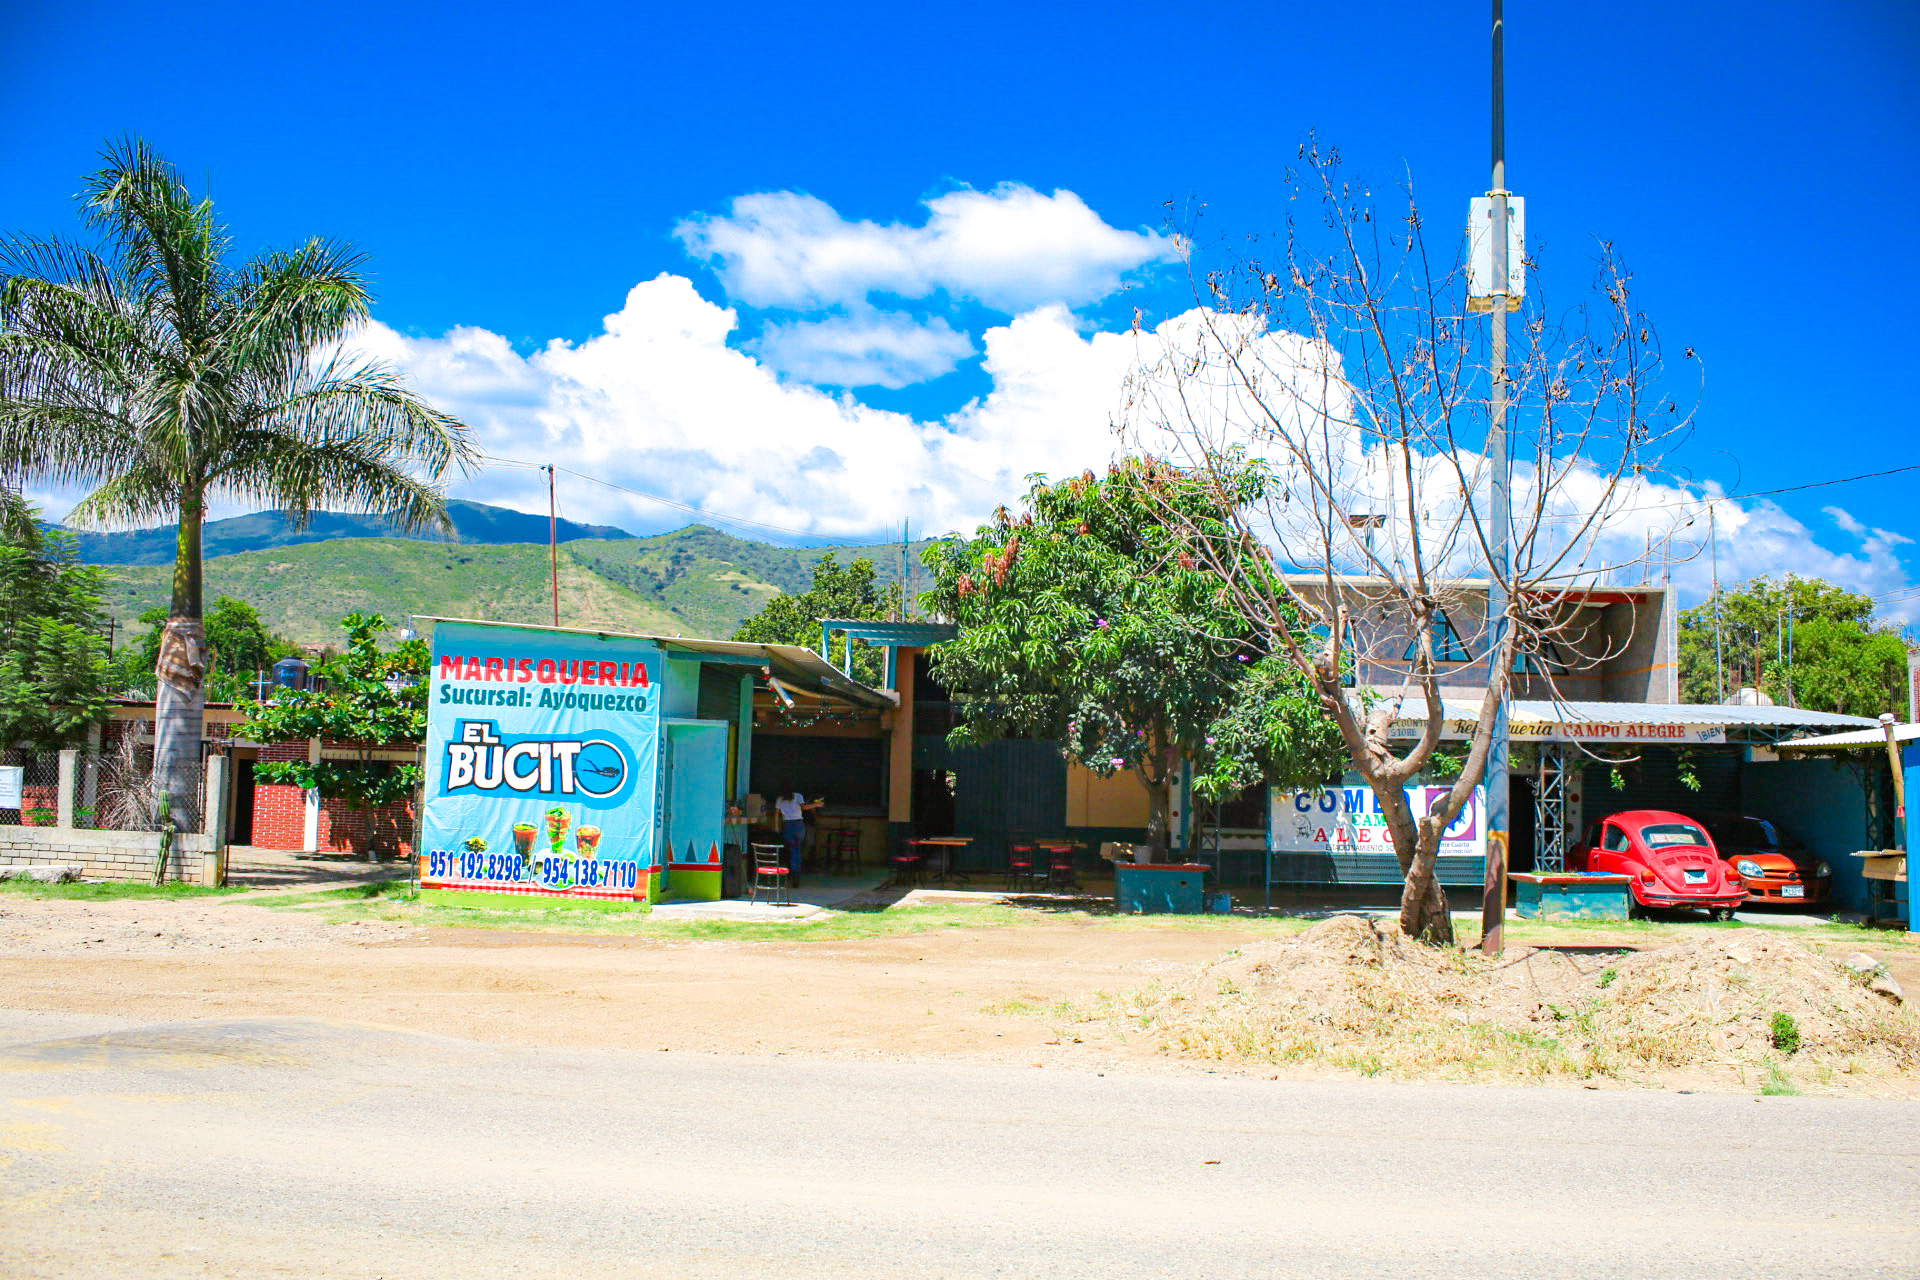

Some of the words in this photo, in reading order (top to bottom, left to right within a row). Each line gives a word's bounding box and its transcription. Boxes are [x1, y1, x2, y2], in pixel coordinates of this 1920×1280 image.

[440, 655, 649, 688] MARISQUERIA
[440, 684, 532, 707] Sucursal:
[539, 688, 647, 712] Ayoquezco
[462, 721, 501, 744] EL
[1563, 724, 1620, 738] CAMPO
[1625, 725, 1686, 738] ALEGRE
[1352, 814, 1388, 826] CAM
[429, 851, 453, 877] 951
[459, 852, 484, 879] 192
[487, 854, 522, 882] 8298
[543, 857, 568, 884] 954
[573, 859, 598, 887] 138
[603, 860, 636, 888] 7110
